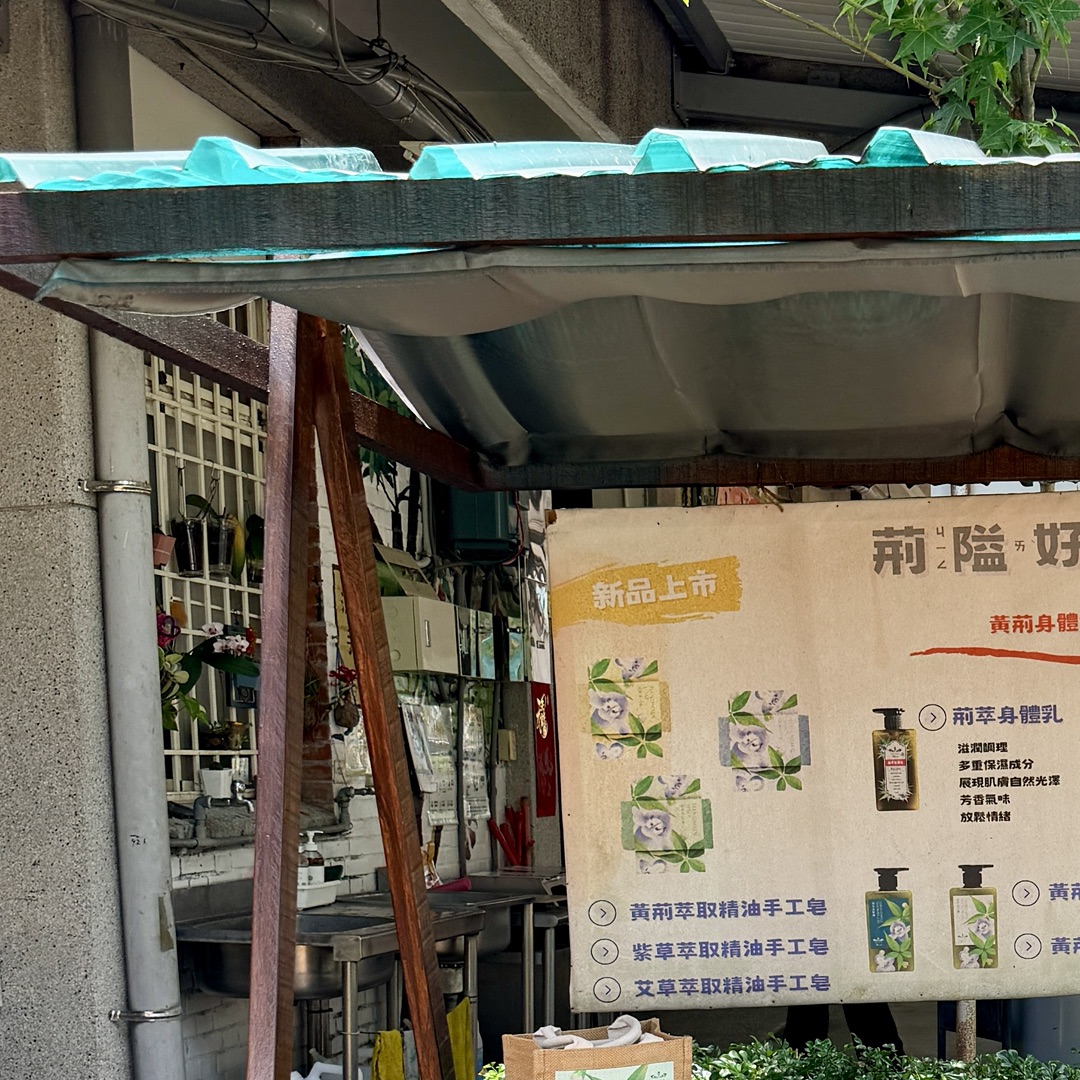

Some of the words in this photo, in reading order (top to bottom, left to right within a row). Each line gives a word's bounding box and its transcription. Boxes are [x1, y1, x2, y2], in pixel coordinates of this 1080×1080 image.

[592, 570, 718, 610] 新品上市
[952, 704, 1064, 726] 荊萃身體乳
[957, 741, 1009, 755] 滋潤調理
[958, 758, 1035, 772] 多重保濕成分
[959, 775, 1061, 789] 展現肌膚自然光澤
[960, 794, 1011, 806] 芳香氣味
[960, 810, 1012, 823] 放鬆情緒
[629, 897, 828, 922] 黃荊萃取精油手工皂
[631, 937, 830, 962] 紫草萃取精油手工皂
[634, 973, 831, 999] 艾草萃取精油手工皂
